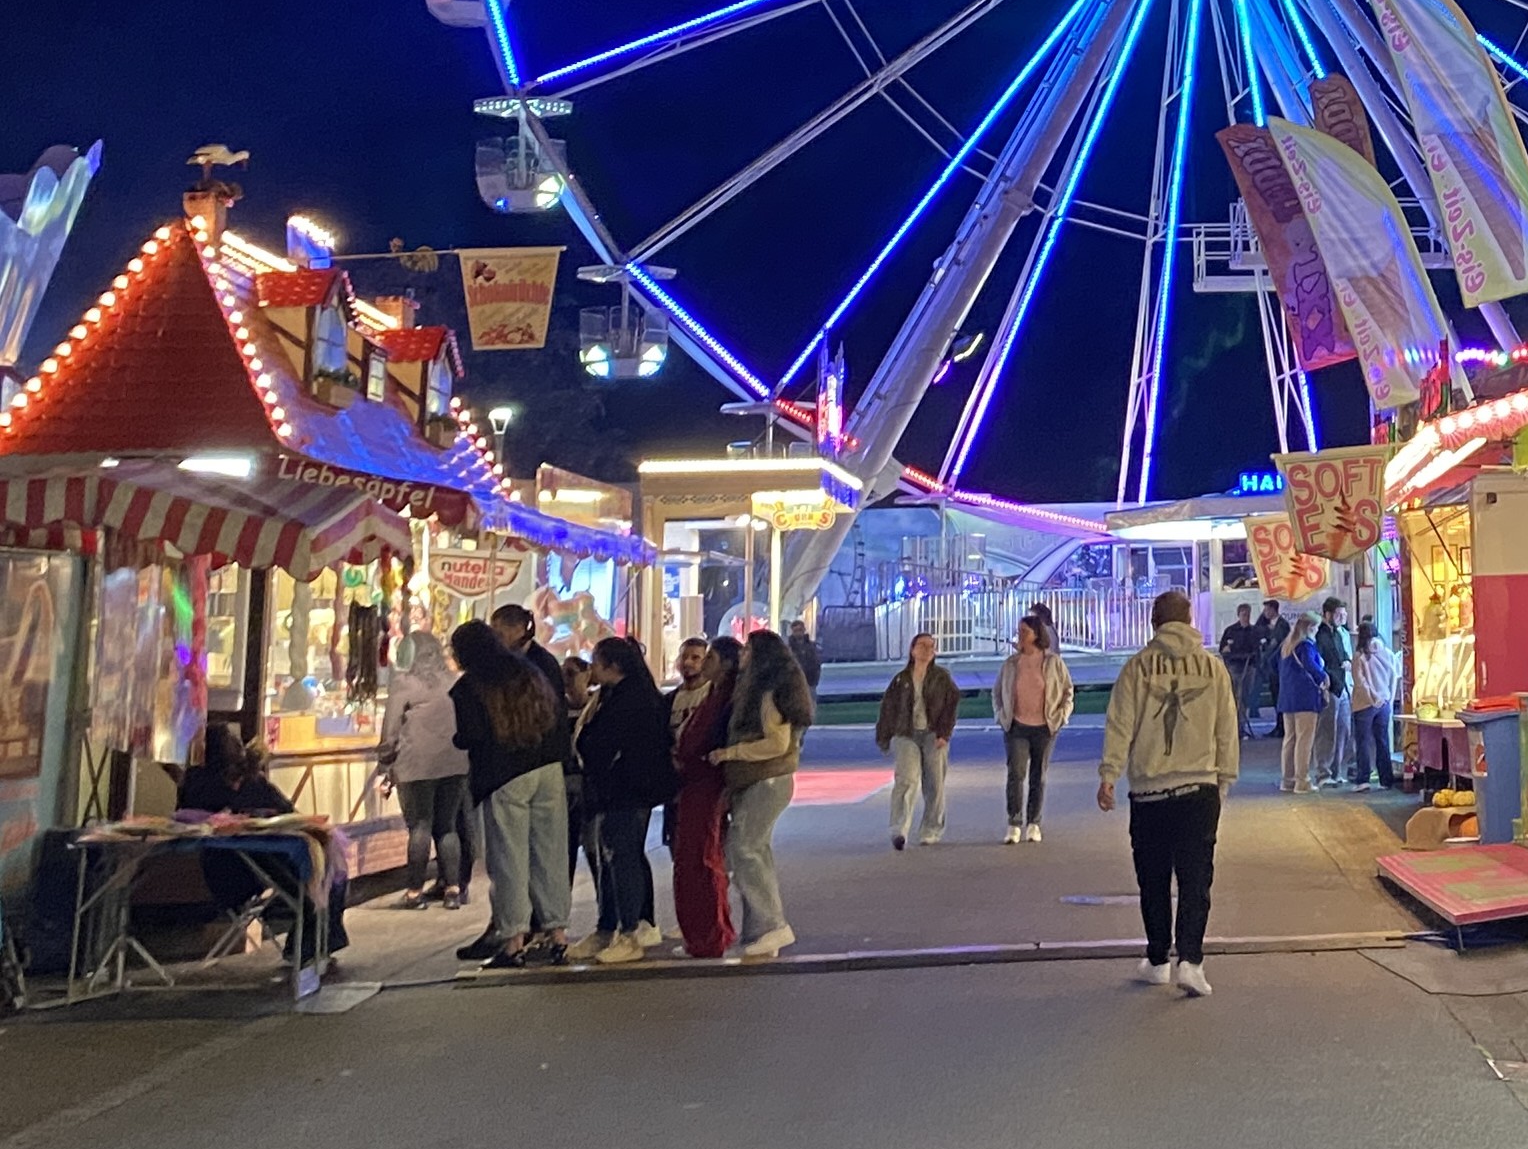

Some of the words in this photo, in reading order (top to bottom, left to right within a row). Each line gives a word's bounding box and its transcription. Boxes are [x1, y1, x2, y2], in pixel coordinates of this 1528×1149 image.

[1288, 458, 1382, 505] SOFT
[441, 558, 504, 576] nutela
[1136, 653, 1213, 678] NIRVANA
